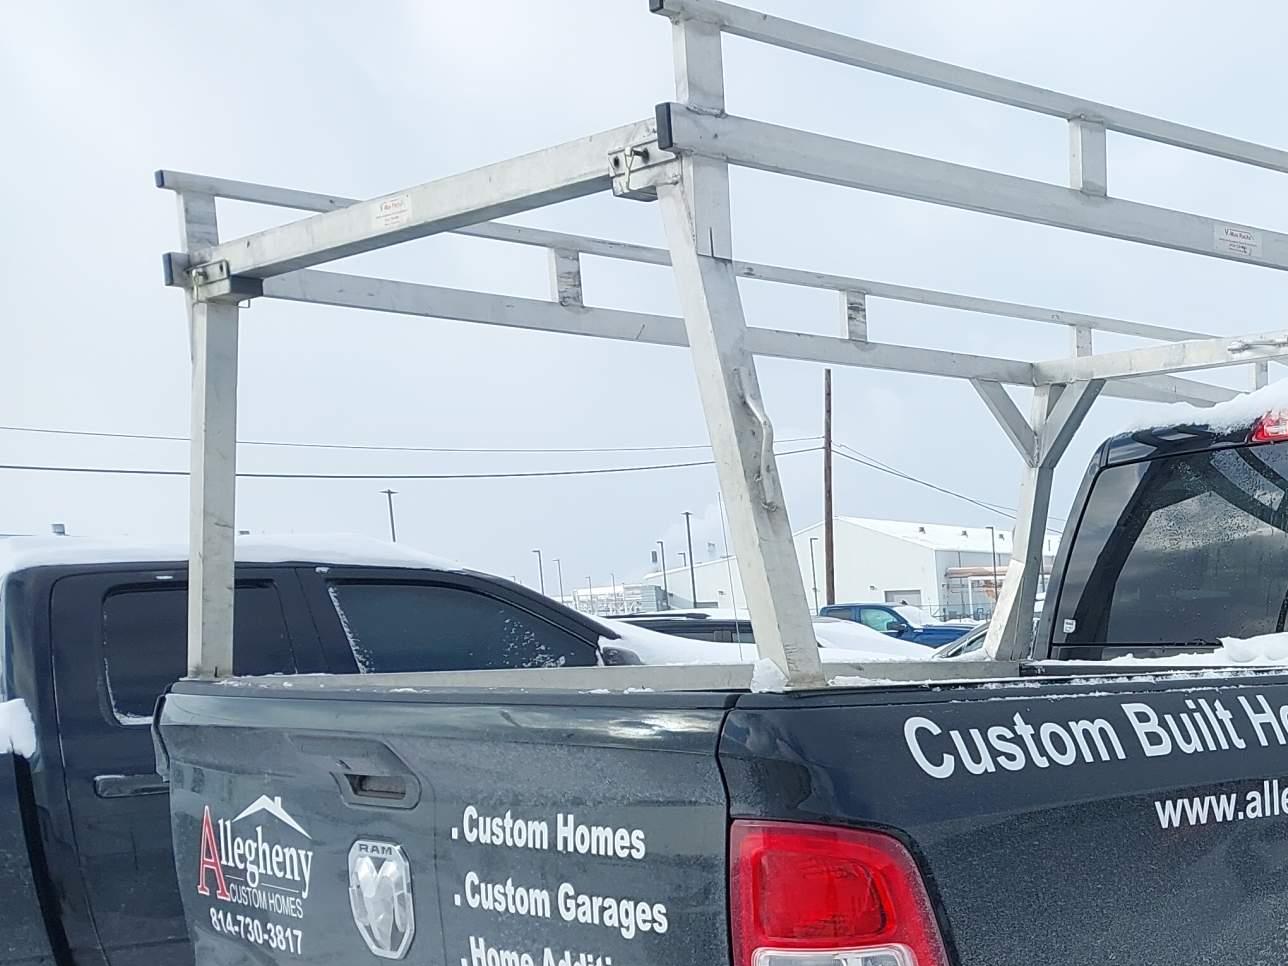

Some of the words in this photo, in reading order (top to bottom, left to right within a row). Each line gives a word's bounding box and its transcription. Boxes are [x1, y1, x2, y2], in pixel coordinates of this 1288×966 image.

[903, 711, 1127, 779] Custom
[1120, 698, 1247, 757] Built
[198, 804, 314, 901] Allegheny
[358, 843, 393, 856] RAM
[556, 812, 646, 860] Homes
[229, 883, 268, 911] CUSTOM
[269, 892, 304, 919] HOMES
[557, 882, 668, 940] Garages
[209, 907, 303, 955] 814-730-3817
